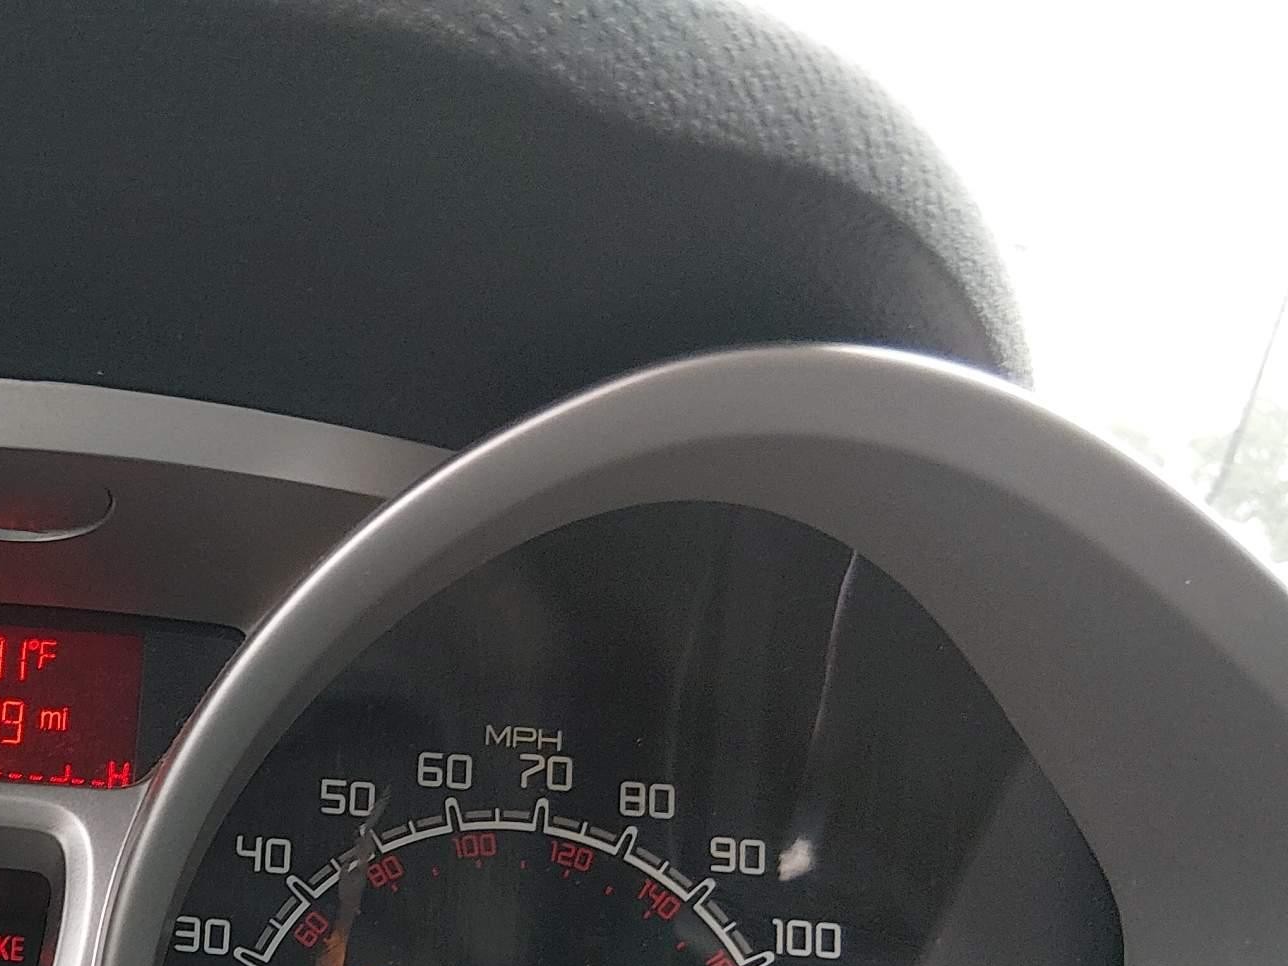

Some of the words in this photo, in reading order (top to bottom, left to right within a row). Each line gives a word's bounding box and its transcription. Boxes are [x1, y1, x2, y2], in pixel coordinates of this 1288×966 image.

[39, 706, 69, 731] mi
[485, 725, 563, 752] MPH
[107, 760, 131, 788] H
[418, 752, 473, 790] 60
[519, 754, 573, 791] 70
[320, 779, 376, 816] 50
[619, 782, 676, 819] 80
[235, 836, 293, 875] 40
[454, 832, 497, 858] 100
[550, 841, 594, 872] 120
[709, 837, 766, 875] 90
[367, 856, 404, 888] 80
[637, 879, 681, 921] 140
[174, 916, 231, 955] 30
[293, 911, 328, 948] 60
[773, 918, 842, 960] 100
